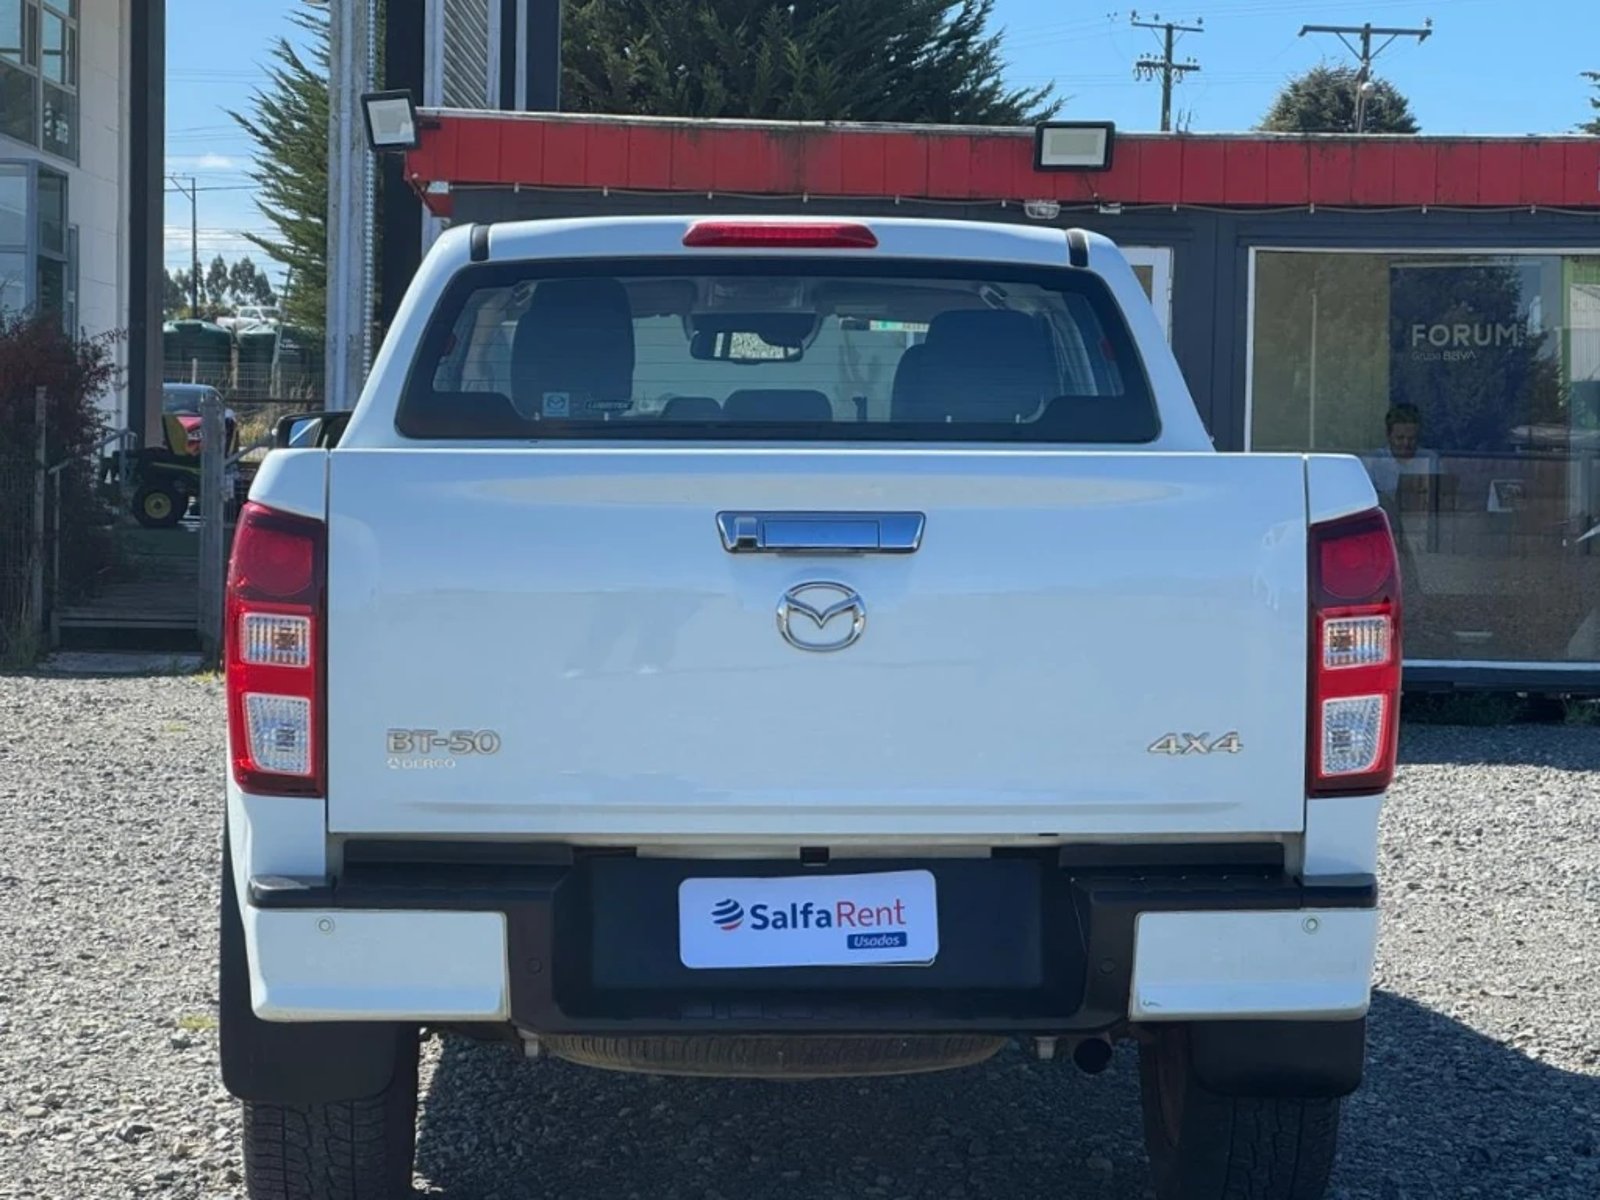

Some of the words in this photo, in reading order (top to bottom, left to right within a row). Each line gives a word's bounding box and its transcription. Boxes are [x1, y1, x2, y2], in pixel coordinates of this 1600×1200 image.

[1411, 323, 1519, 348] FORUM
[386, 728, 502, 755] BT-50
[853, 934, 901, 948] Usados
